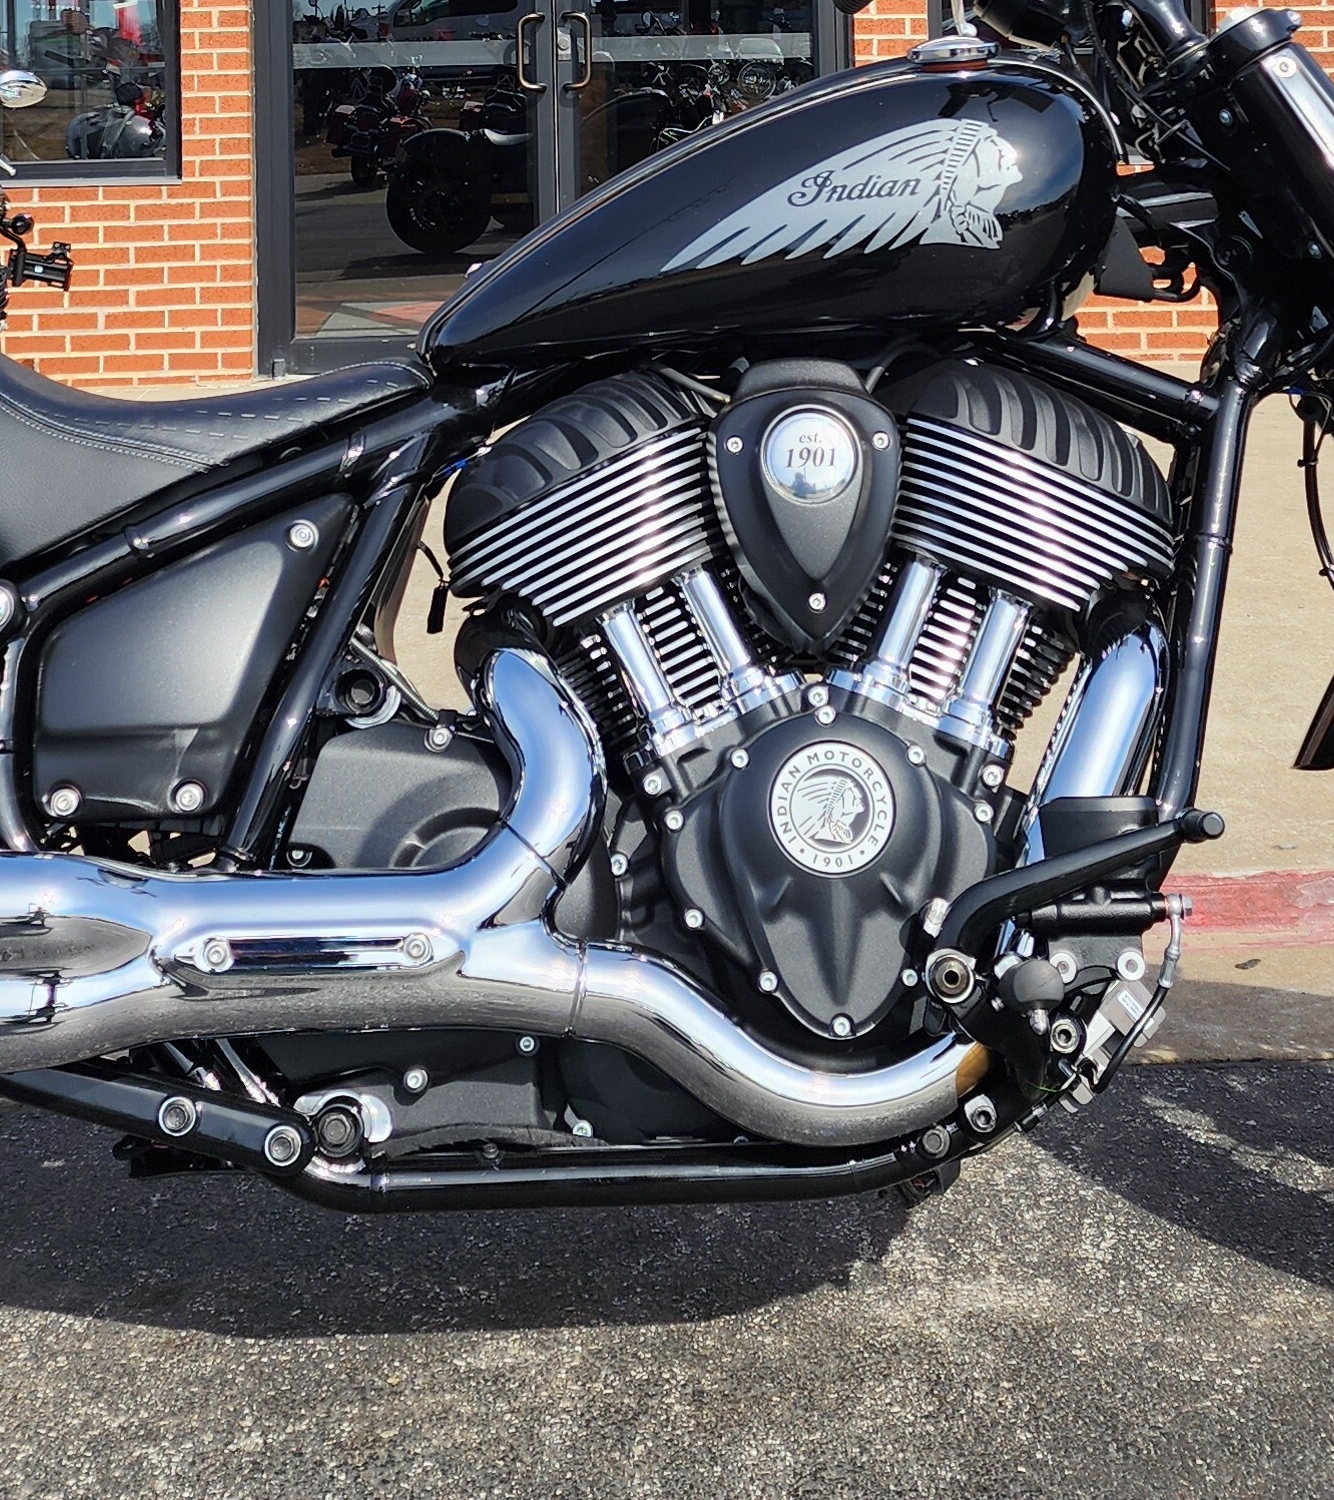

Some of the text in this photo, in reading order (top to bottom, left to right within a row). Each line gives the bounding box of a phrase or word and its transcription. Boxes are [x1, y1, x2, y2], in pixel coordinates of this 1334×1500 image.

[787, 169, 920, 208] Indian
[798, 431, 823, 444] est.
[785, 447, 838, 469] 1901
[777, 750, 888, 847] INDIAN MOTORCYCLE
[812, 854, 854, 868] 1901
